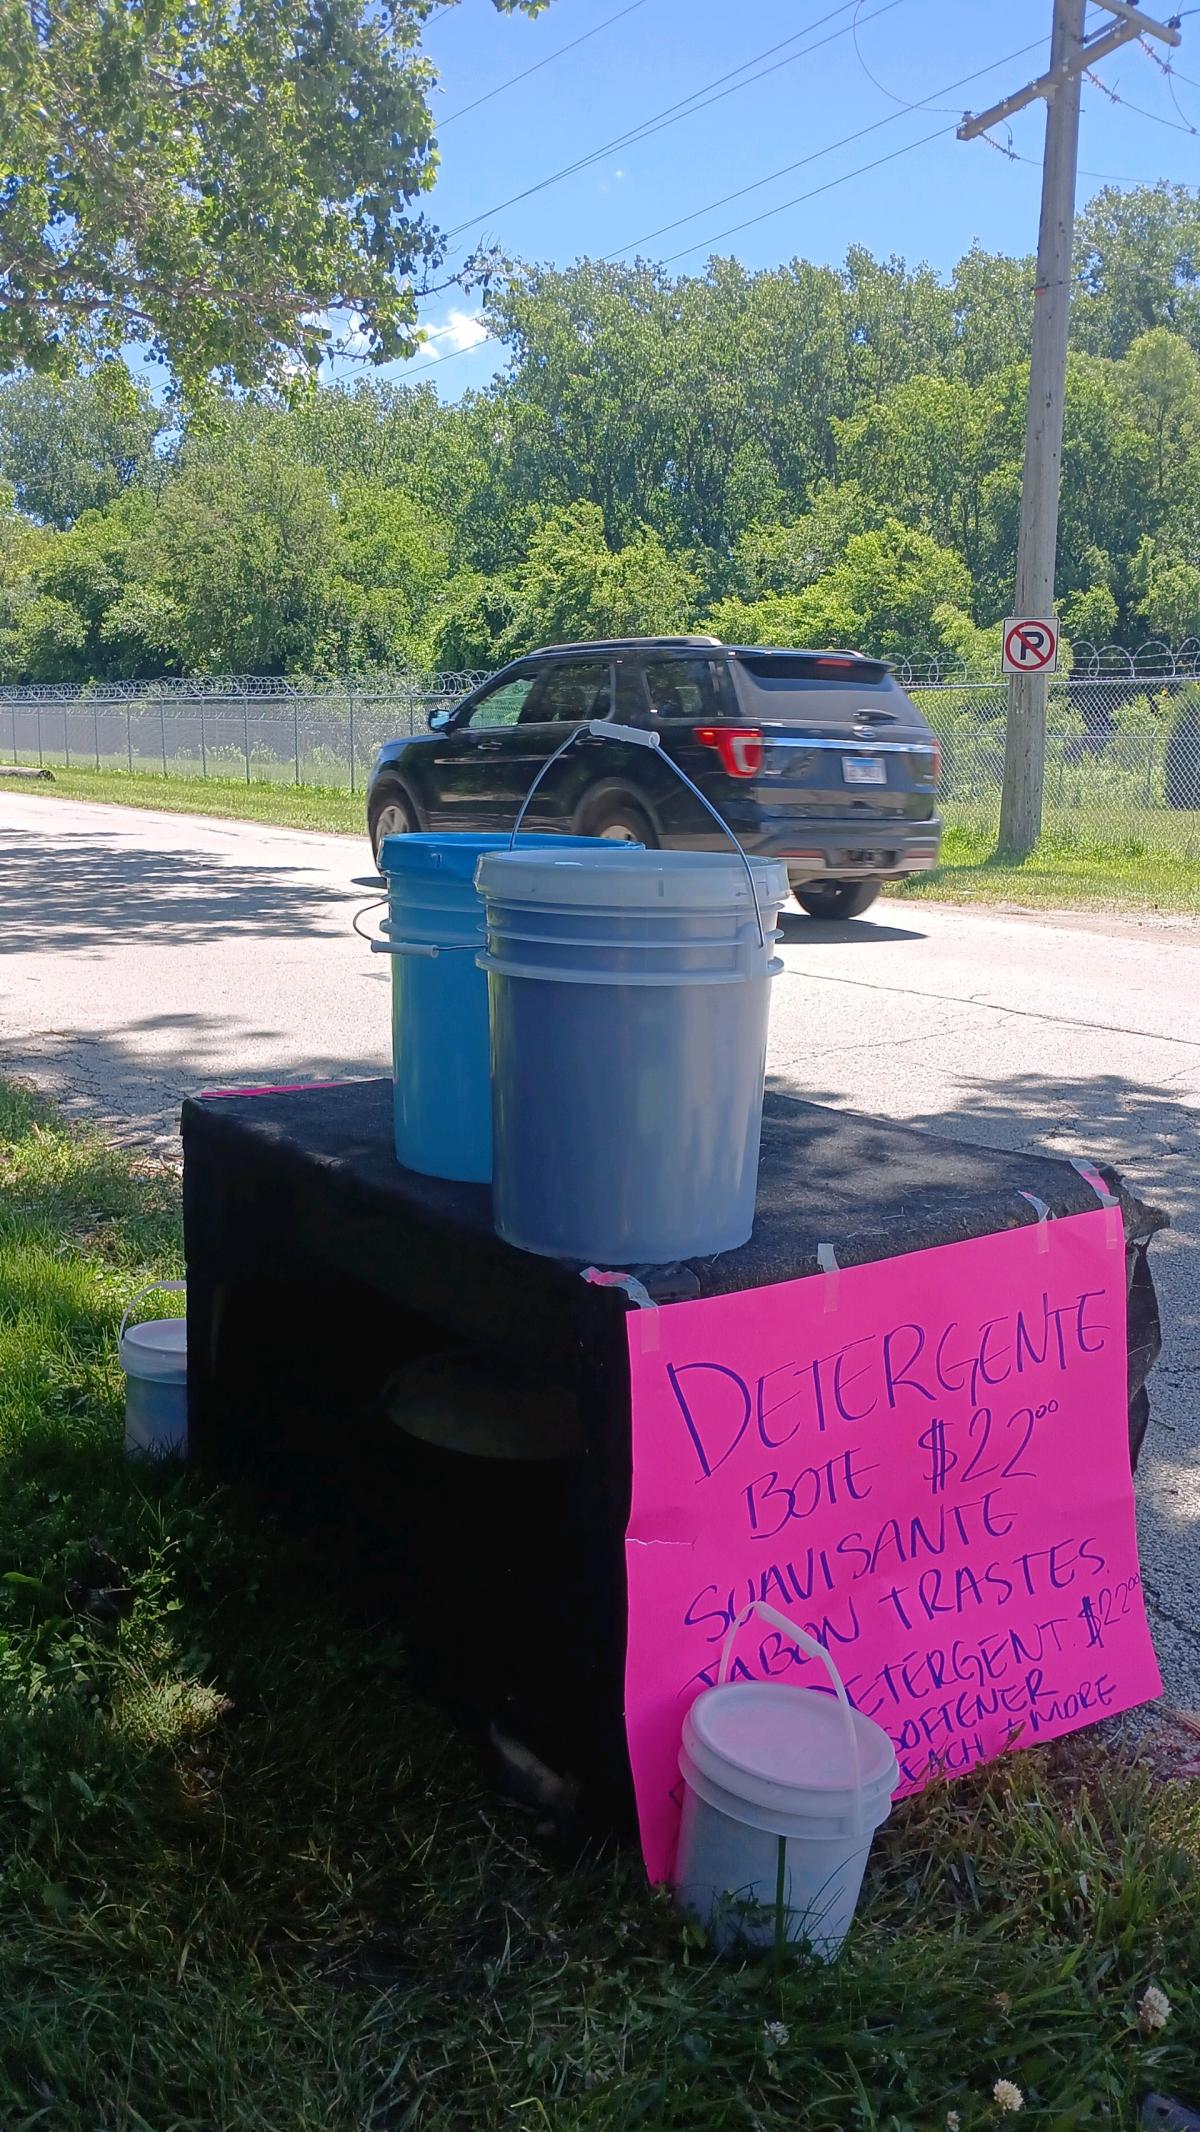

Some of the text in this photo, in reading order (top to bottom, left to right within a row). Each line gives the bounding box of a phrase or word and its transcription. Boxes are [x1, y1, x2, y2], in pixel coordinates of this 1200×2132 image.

[1020, 632, 1044, 660] P
[666, 1289, 1110, 1484] DETERGENTE
[741, 1448, 880, 1540] BOTE
[684, 1488, 1017, 1642] SUAVISANTE
